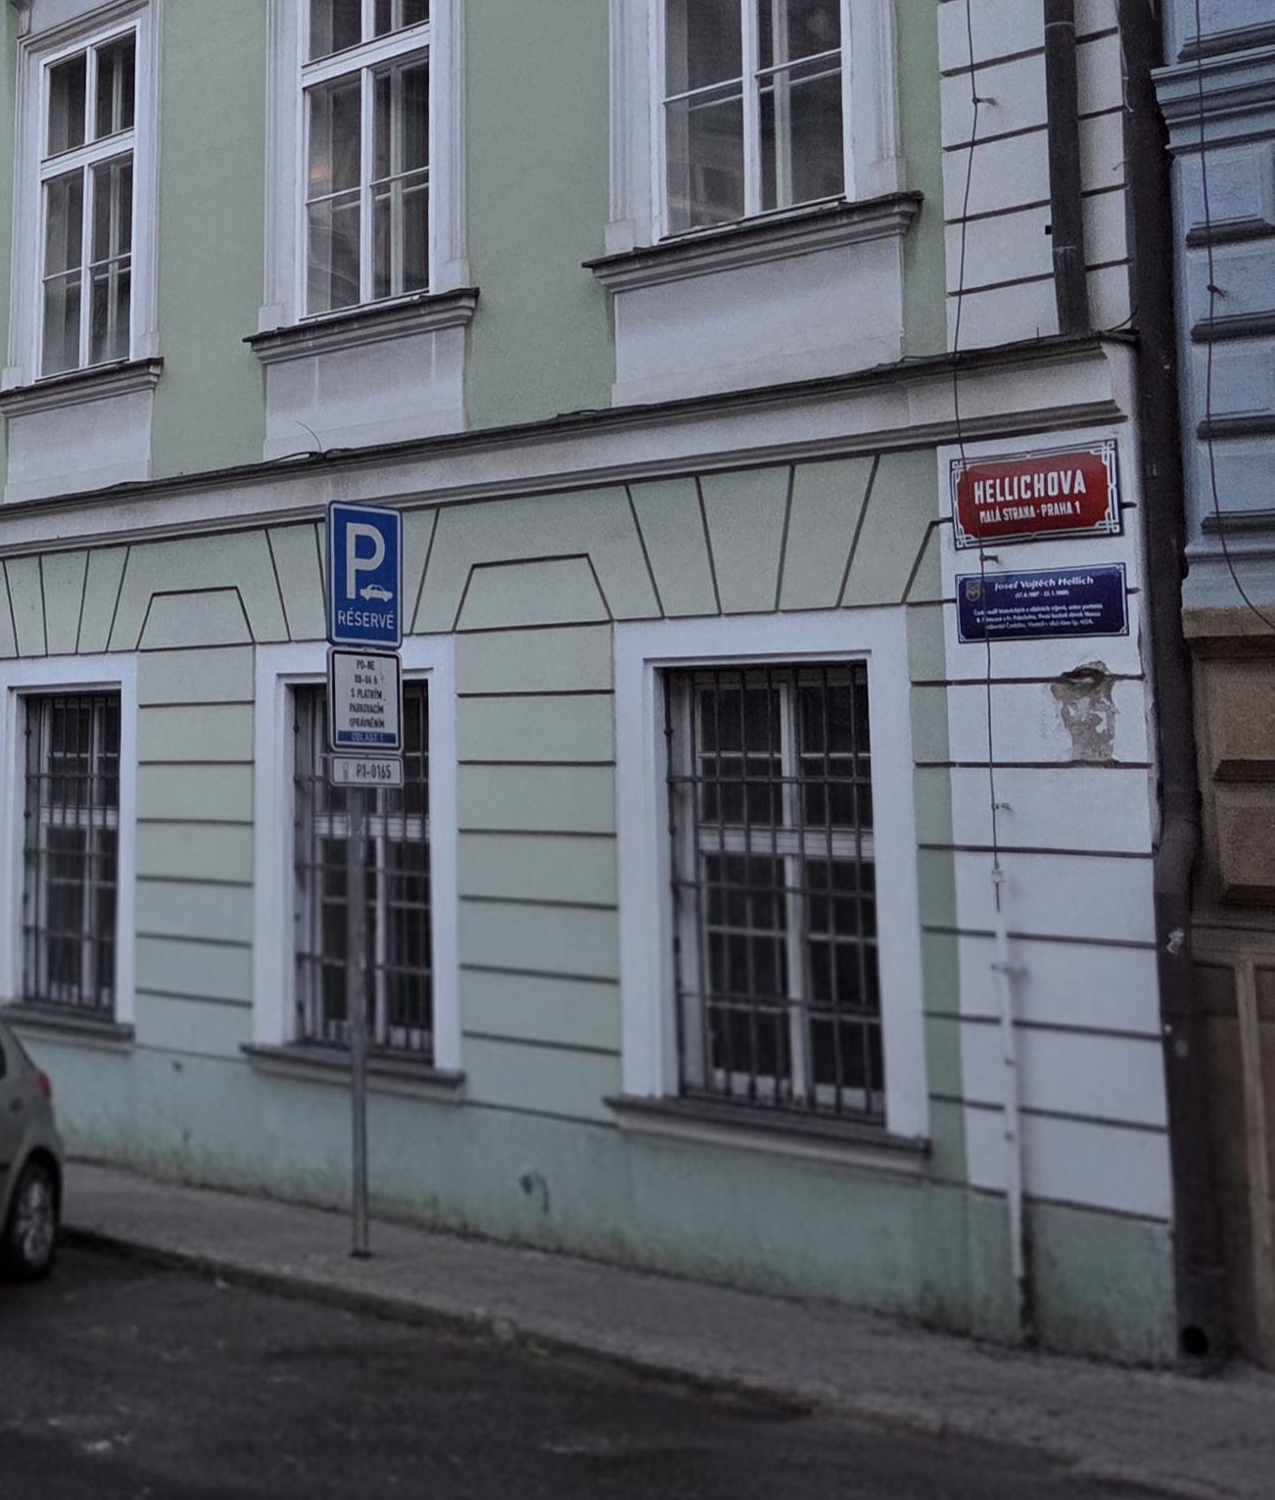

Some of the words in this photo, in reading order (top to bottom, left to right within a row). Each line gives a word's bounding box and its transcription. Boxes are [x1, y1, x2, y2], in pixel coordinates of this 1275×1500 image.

[974, 469, 1087, 505] HELLICHOVA
[980, 507, 1001, 524] MALÁ
[1003, 504, 1036, 521] STRANA
[1041, 502, 1073, 518] PRAHA
[1074, 500, 1081, 514] 1
[346, 522, 385, 599] P
[994, 581, 1018, 592] Josef
[1058, 575, 1094, 587] Hellich
[337, 607, 395, 630] RÉSERVÉ
